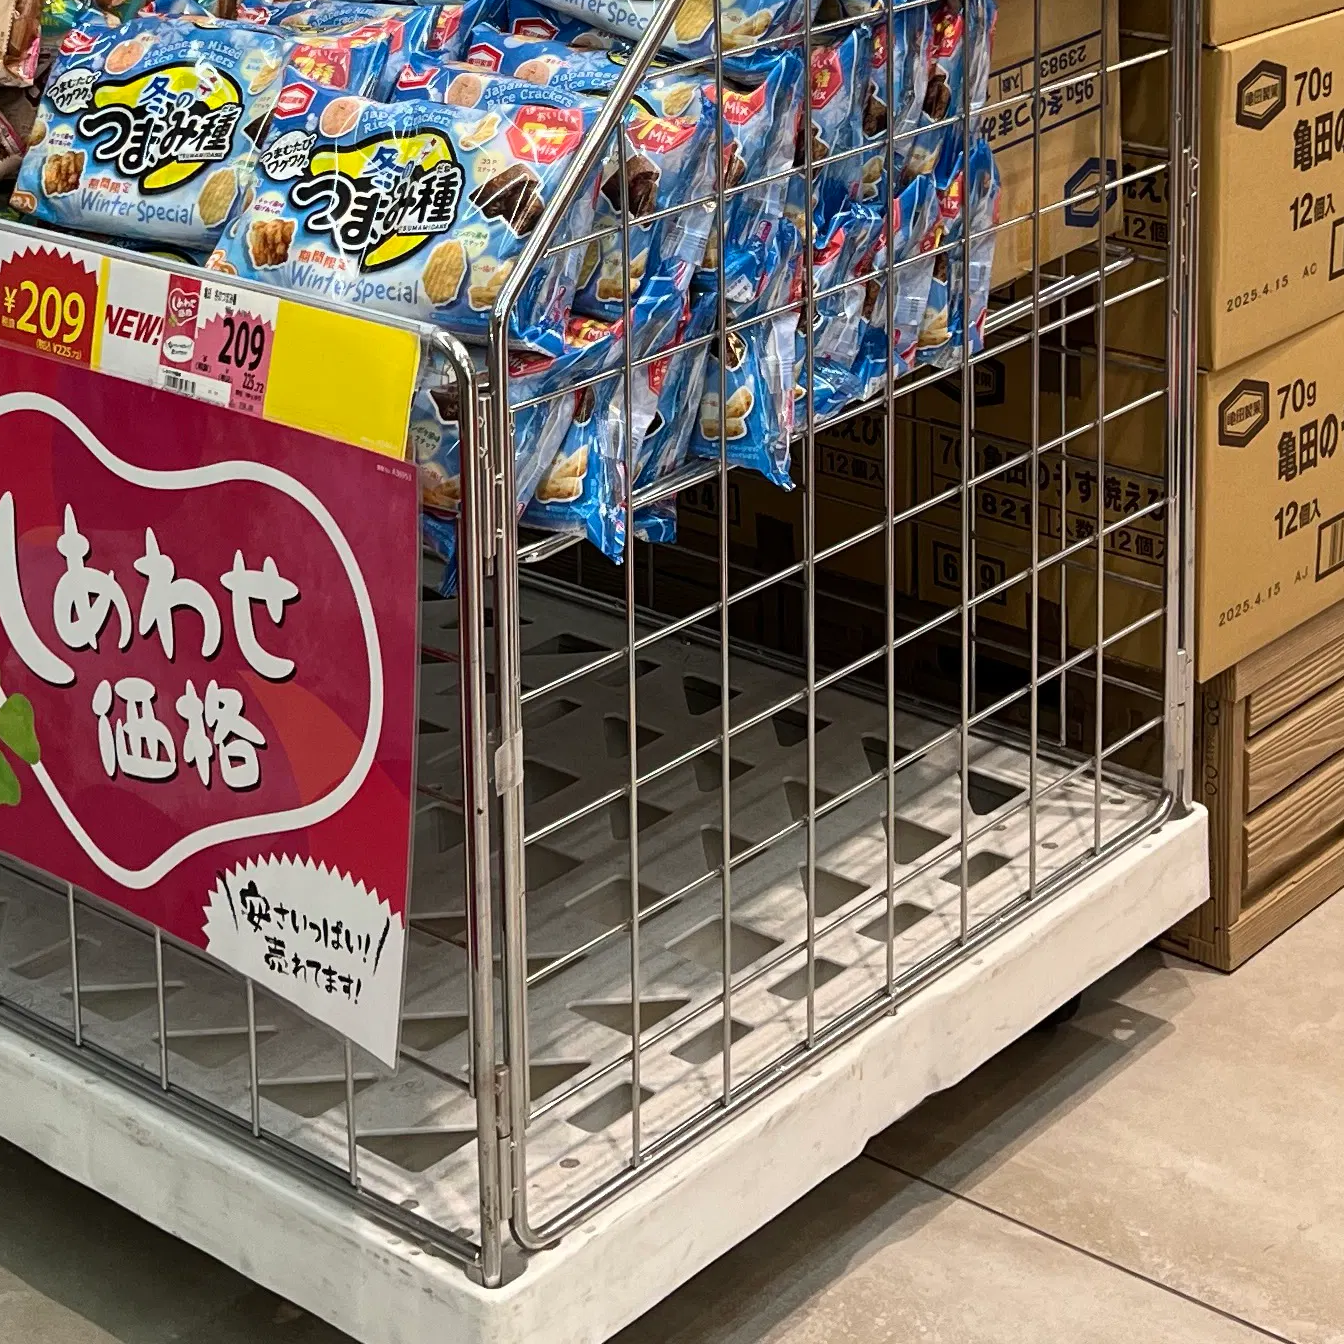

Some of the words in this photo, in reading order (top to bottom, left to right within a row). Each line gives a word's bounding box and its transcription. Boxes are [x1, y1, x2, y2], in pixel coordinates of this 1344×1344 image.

[141, 76, 194, 116] 冬の
[522, 87, 574, 108] Crackers
[1293, 66, 1333, 106] 70g
[79, 104, 240, 177] つまみ種
[261, 137, 314, 166] つまむたび
[80, 188, 135, 216] Winter
[137, 202, 196, 226] Special
[294, 169, 461, 251] つまみ種
[1289, 192, 1336, 232] 12個入
[289, 260, 353, 294] Winter
[355, 279, 420, 305] Special
[4, 280, 85, 344] ¥209
[105, 304, 164, 346] NEW!
[218, 317, 265, 371] 209
[1277, 378, 1317, 420] 70g
[1274, 498, 1321, 541] 12個入
[92, 676, 267, 790] 価格
[238, 878, 371, 956] 安さいっぱい!
[263, 936, 362, 1006] 売れてます!
